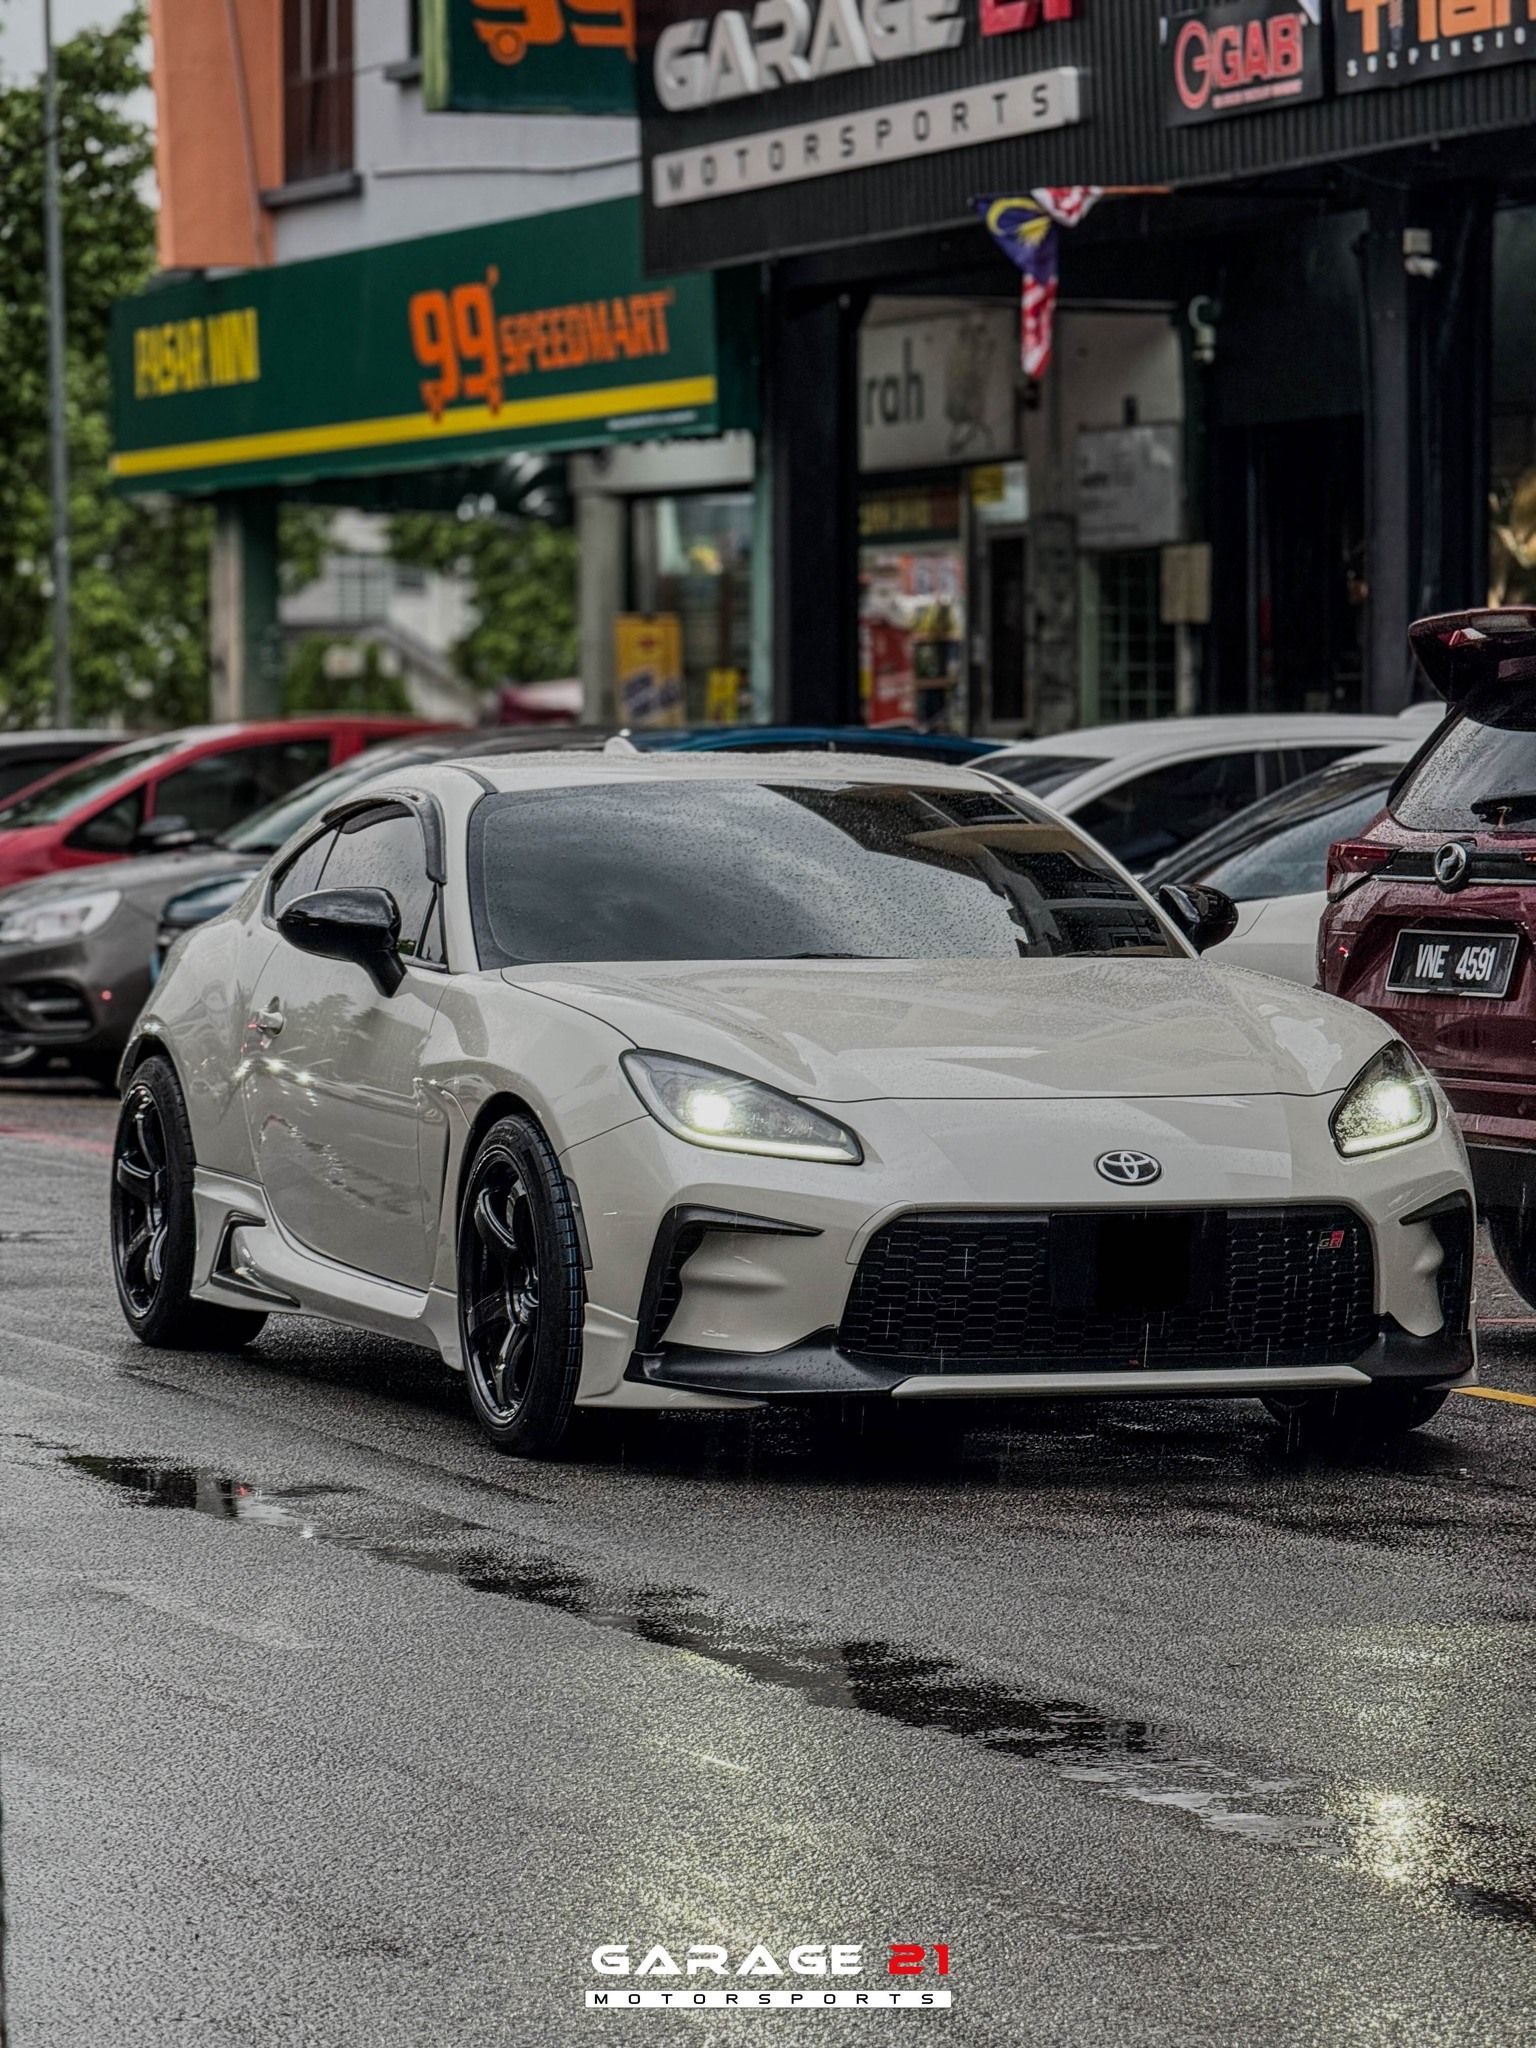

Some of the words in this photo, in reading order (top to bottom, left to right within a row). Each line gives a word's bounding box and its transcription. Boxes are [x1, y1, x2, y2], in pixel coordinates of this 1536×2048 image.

[654, 0, 966, 112] GARAGE
[667, 84, 1051, 192] MOTORSPORTS
[408, 280, 502, 421] 99
[1414, 943, 1451, 979] VNE
[1454, 945, 1498, 981] 4591
